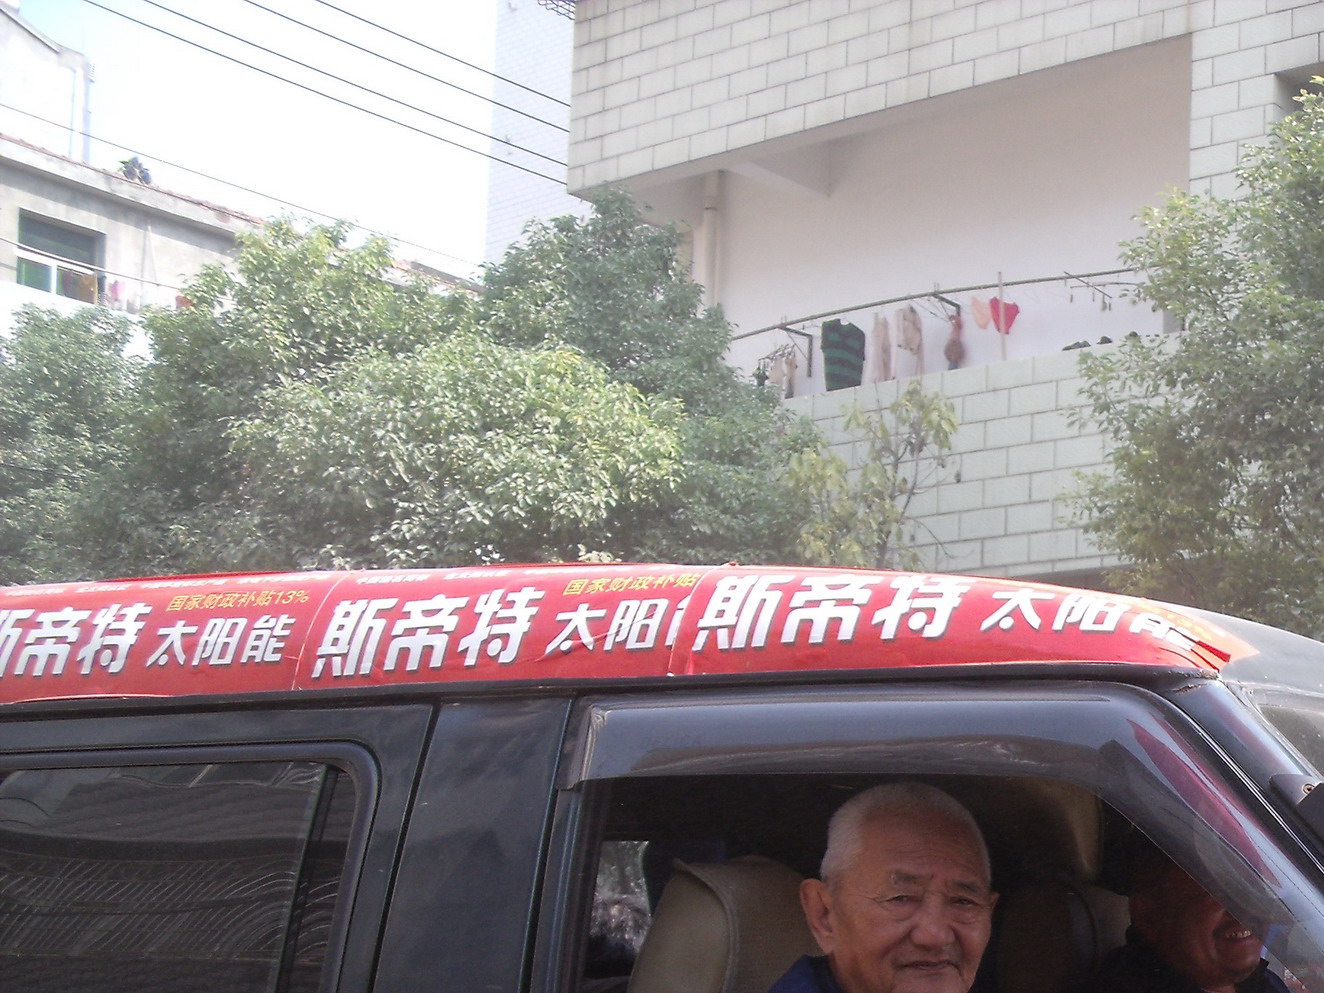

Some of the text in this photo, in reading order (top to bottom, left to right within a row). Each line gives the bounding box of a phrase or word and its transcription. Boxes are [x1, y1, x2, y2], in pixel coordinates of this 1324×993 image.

[166, 590, 309, 612] 国家财政补贴13%
[311, 587, 690, 680] 斯帝特 太阳
[692, 574, 970, 652] 斯帝特
[145, 614, 296, 668] 太阳能
